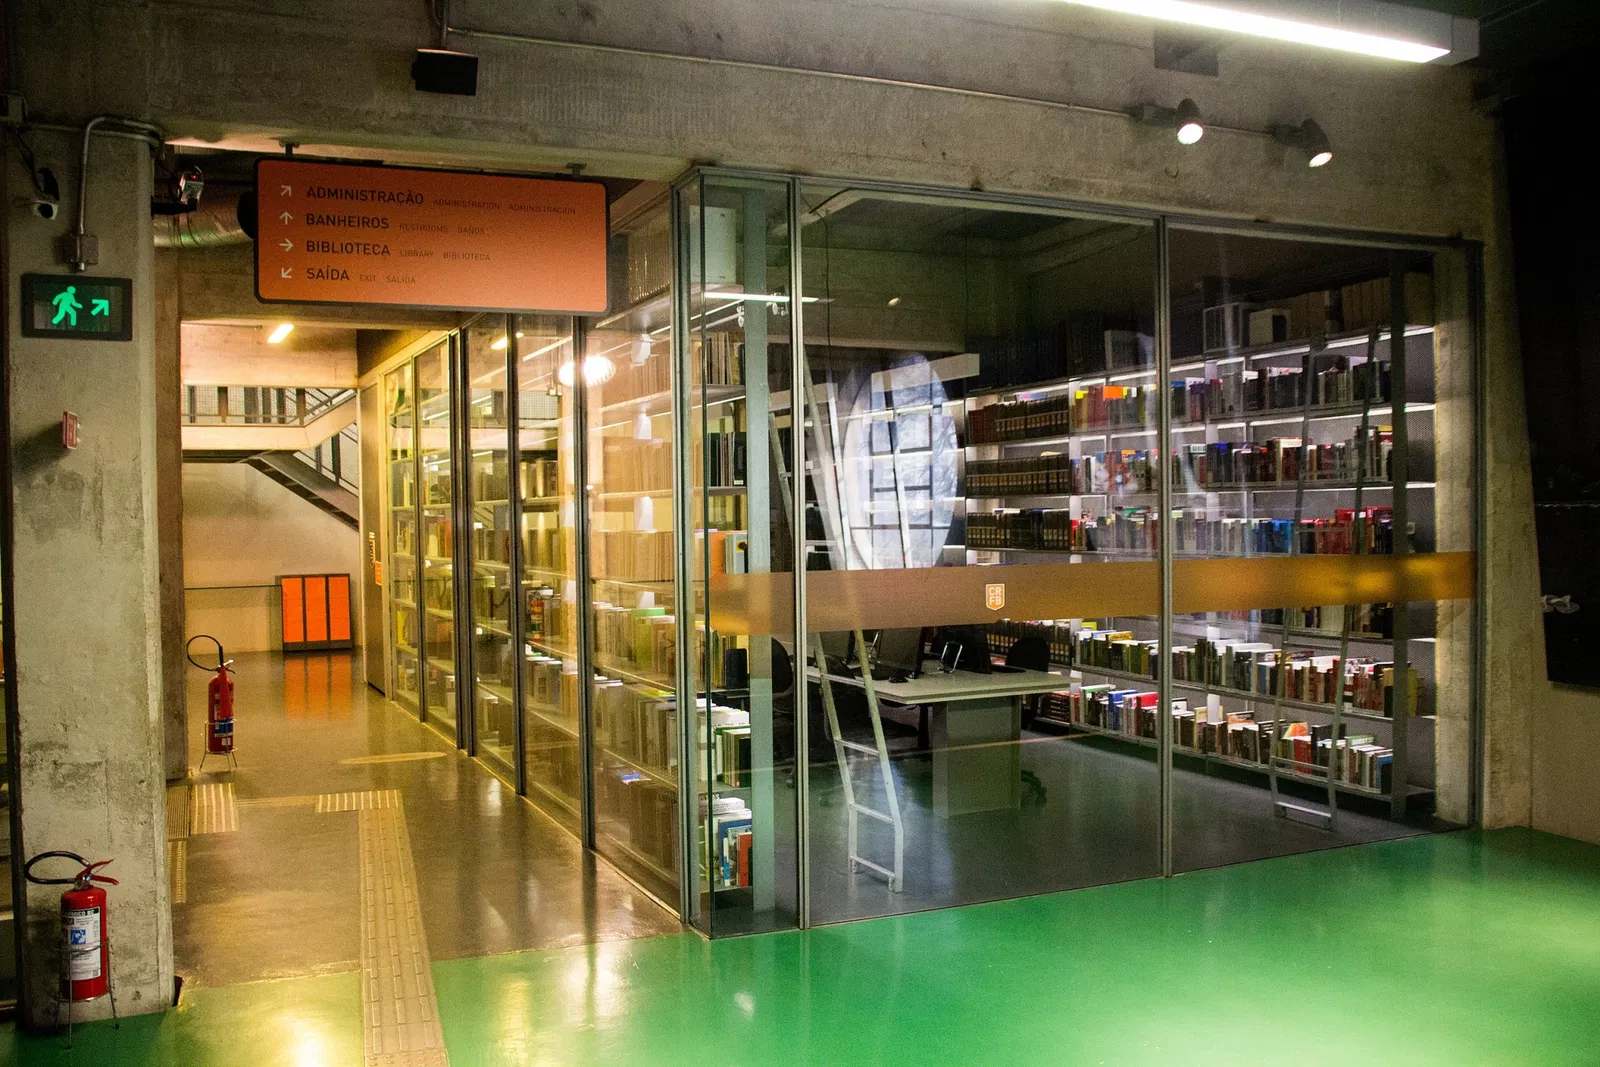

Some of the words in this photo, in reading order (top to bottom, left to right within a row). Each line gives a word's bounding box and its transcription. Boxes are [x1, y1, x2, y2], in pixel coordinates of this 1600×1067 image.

[306, 185, 425, 205] ADMINISTRAÇÃO
[306, 213, 390, 229] BANHEIROS
[399, 223, 449, 233] RESTROOMS
[306, 240, 391, 256] BIBLIOTECA
[400, 249, 434, 258] LIBRARY
[443, 251, 491, 261] BIBLIOTECA
[306, 265, 350, 281] SAÍDA
[360, 274, 377, 282] EXIT
[386, 275, 416, 284] SALIDA
[989, 586, 1002, 596] CR
[989, 596, 1002, 605] FB
